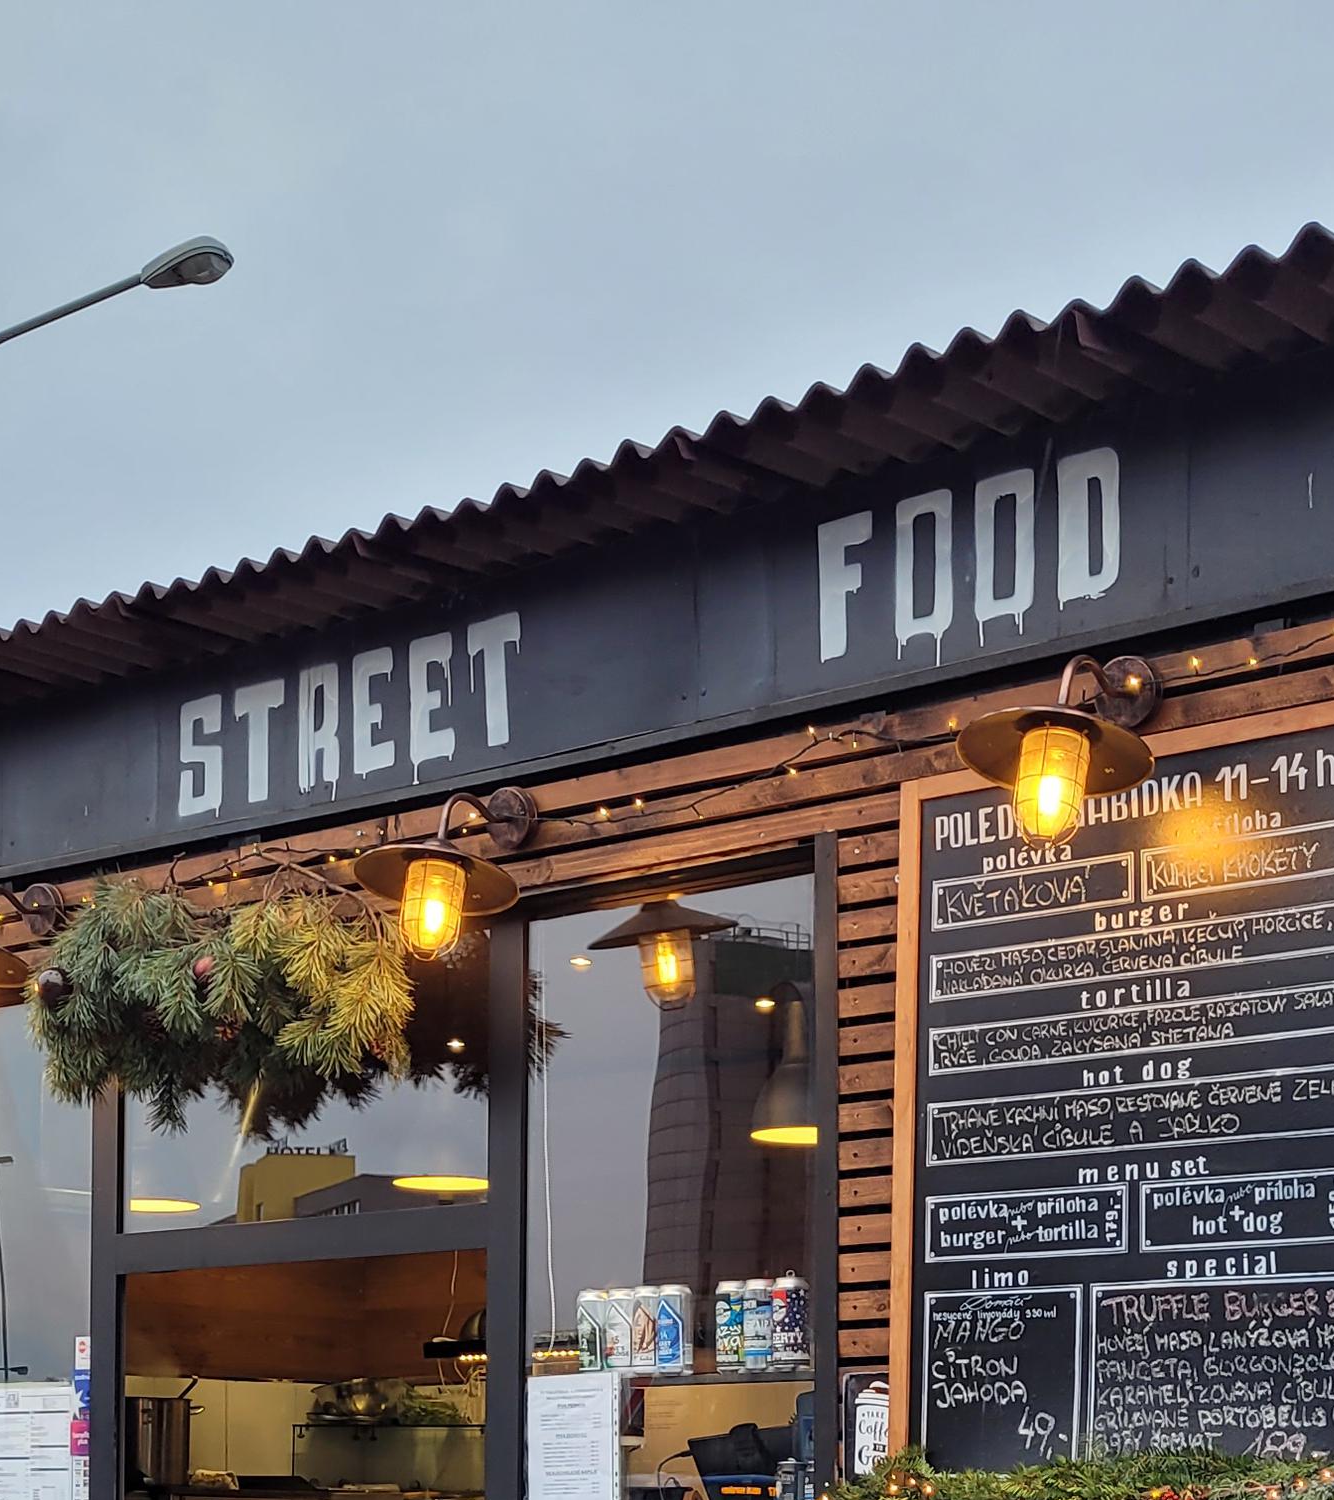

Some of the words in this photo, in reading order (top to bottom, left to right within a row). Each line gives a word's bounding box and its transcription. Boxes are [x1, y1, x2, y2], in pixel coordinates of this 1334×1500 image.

[178, 612, 521, 817] STREET
[818, 447, 1119, 666] FOOD
[935, 803, 1024, 850] POLED
[983, 844, 1071, 874] polévka
[1095, 902, 1189, 932] burger
[1081, 978, 1190, 1009] tortilla
[985, 1028, 1017, 1045] CON
[1083, 1065, 1124, 1087] hot
[1142, 1057, 1192, 1080] dog
[1129, 1121, 1143, 1142] A
[1078, 1161, 1159, 1184] menu
[1171, 1155, 1210, 1177] set
[1153, 1185, 1226, 1210] polévka
[1254, 1178, 1316, 1204] příloha
[939, 1199, 1008, 1224] polévka
[1037, 1196, 1099, 1218] příloha
[1192, 1215, 1228, 1235] hot
[1242, 1211, 1283, 1235] dog
[940, 1229, 1006, 1249] burger
[1037, 1219, 1099, 1242] tortilla
[972, 1268, 1029, 1289] limo
[1167, 1251, 1277, 1279] special
[1101, 1291, 1211, 1325] TRUFFLE
[934, 1319, 1025, 1349] MANGO
[932, 1380, 1028, 1409] JAHODA
